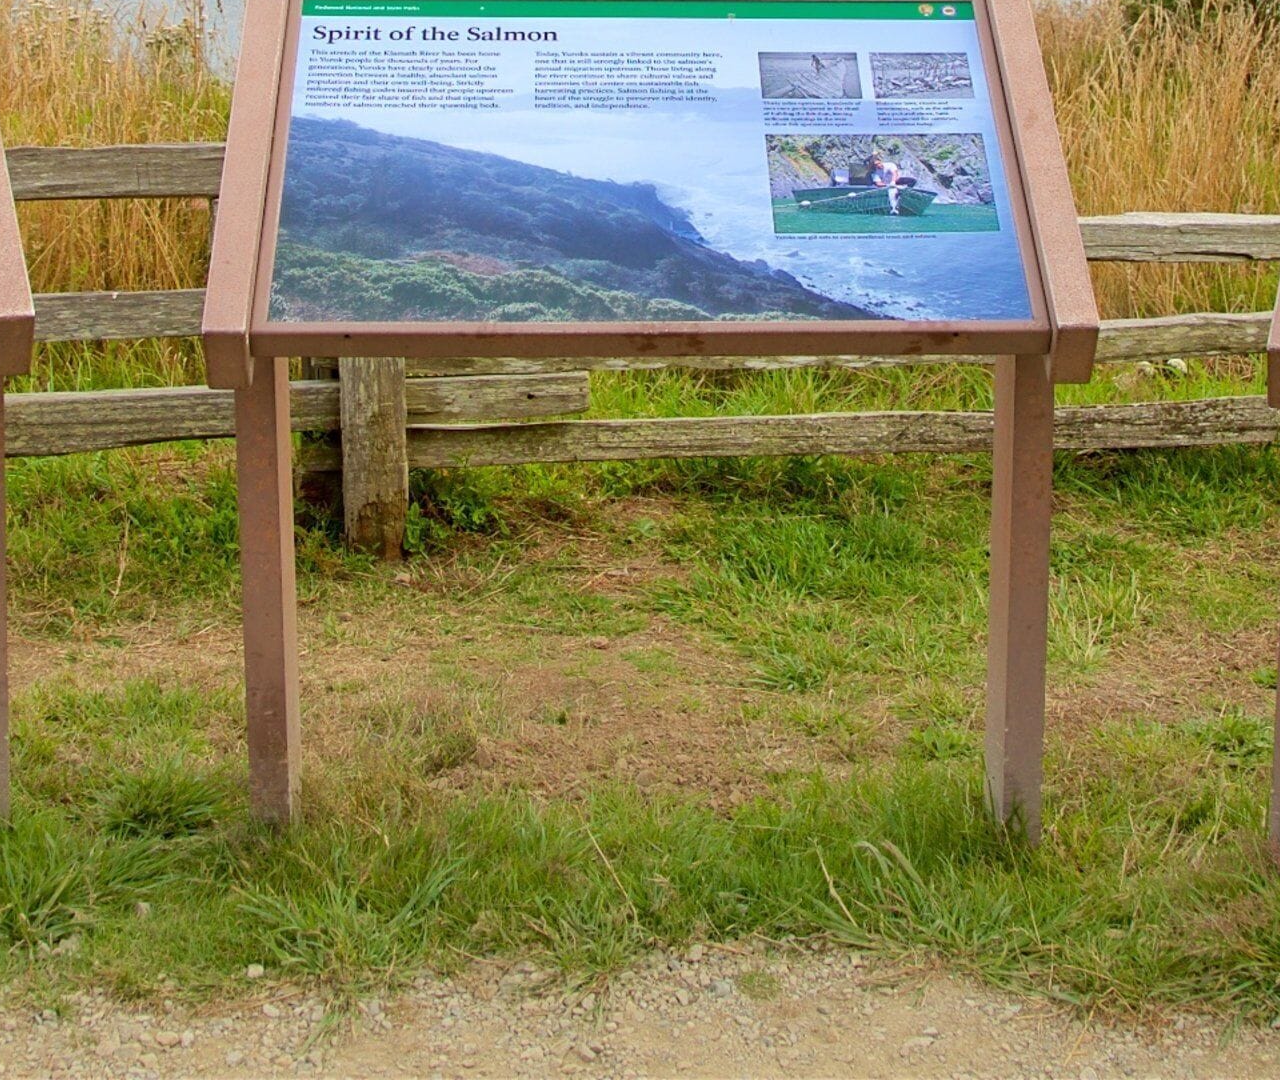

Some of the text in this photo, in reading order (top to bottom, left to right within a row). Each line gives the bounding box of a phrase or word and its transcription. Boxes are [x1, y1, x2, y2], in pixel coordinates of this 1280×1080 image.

[312, 25, 558, 45] Spirit of the Salmon
